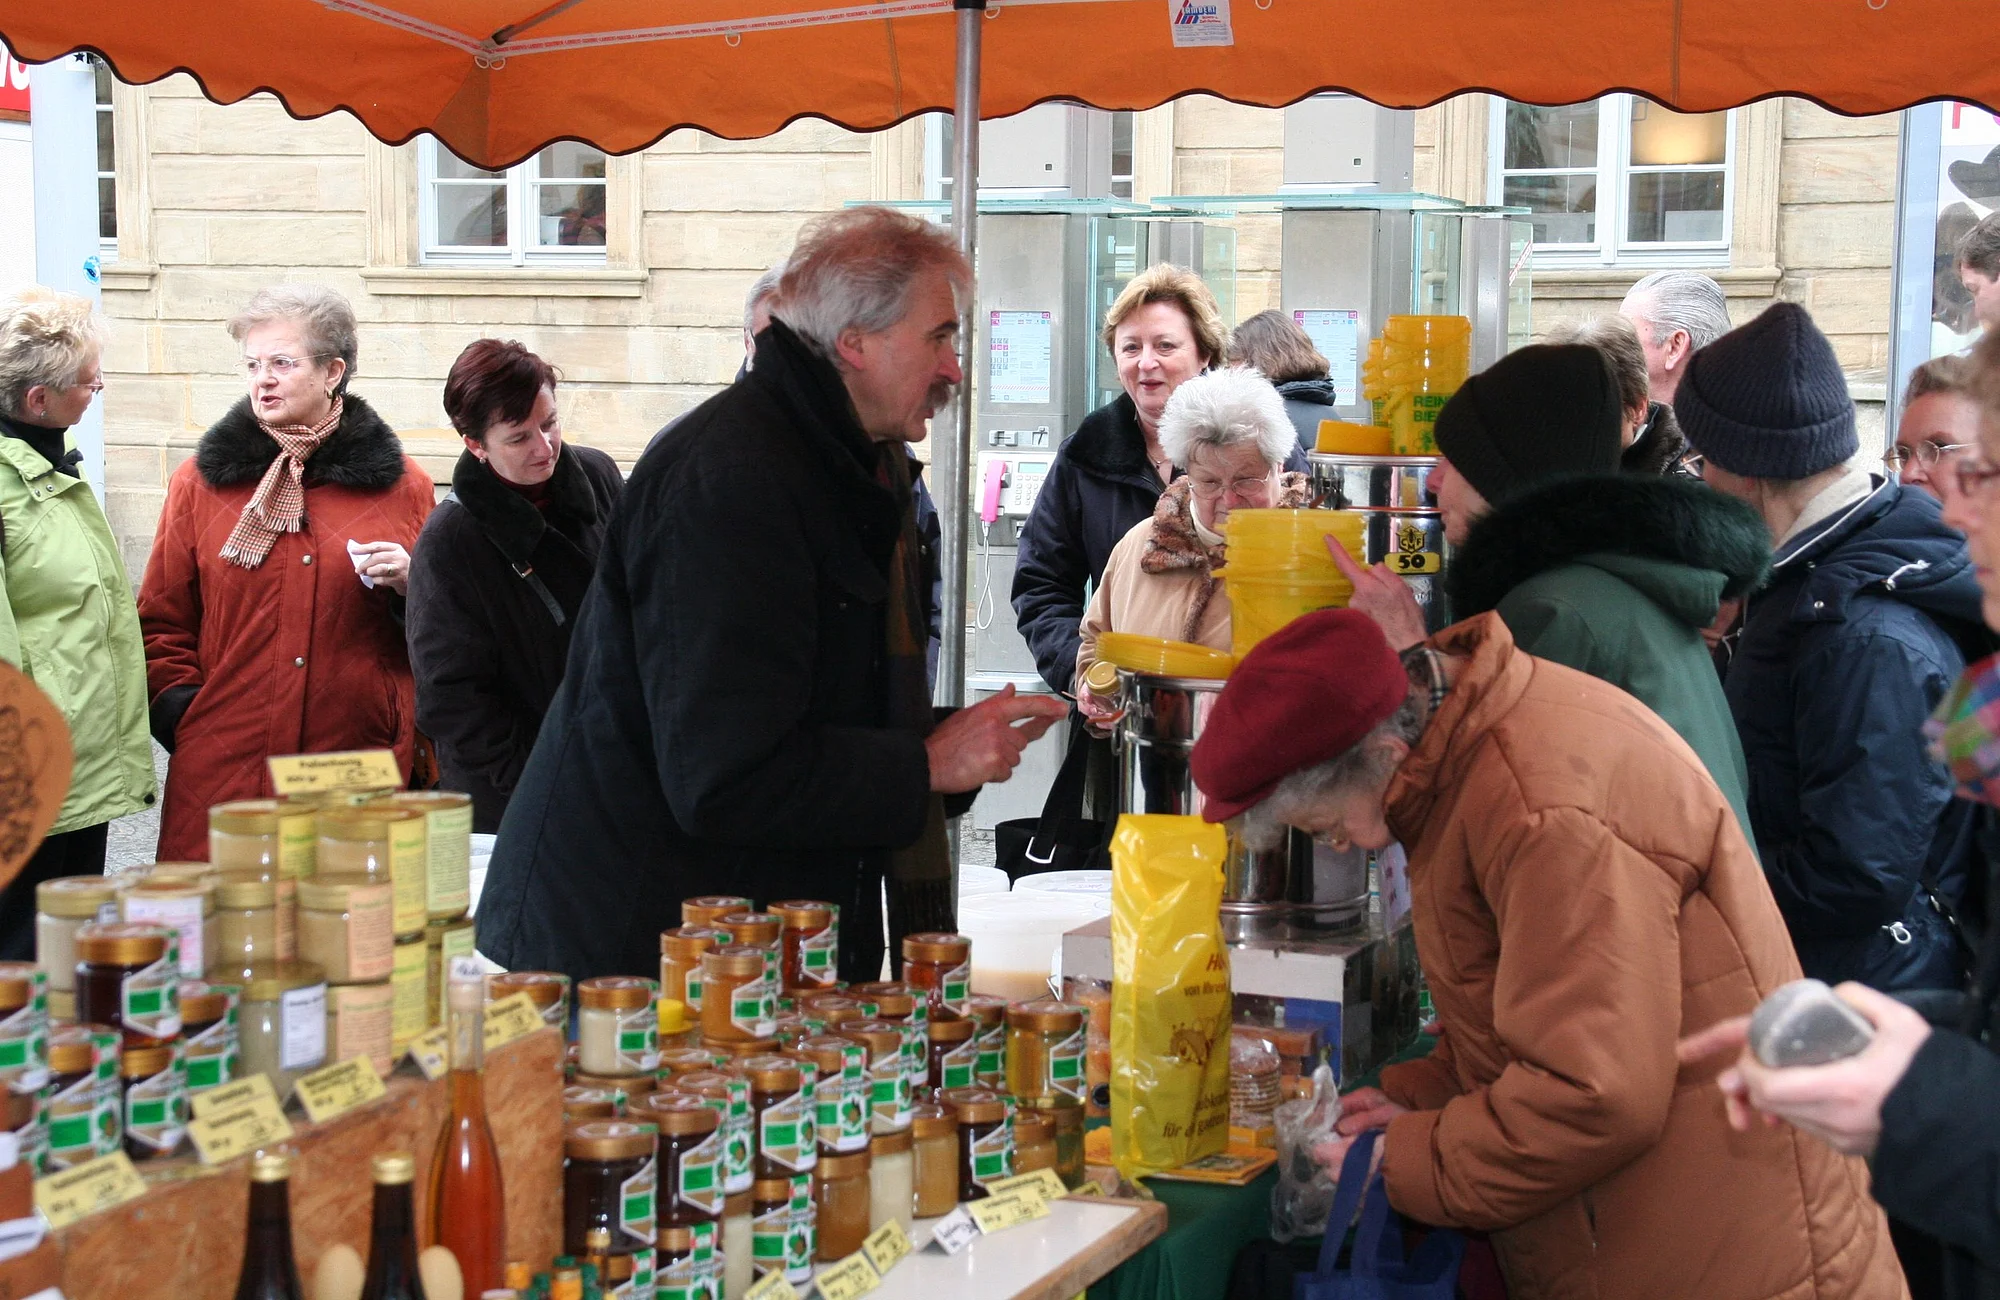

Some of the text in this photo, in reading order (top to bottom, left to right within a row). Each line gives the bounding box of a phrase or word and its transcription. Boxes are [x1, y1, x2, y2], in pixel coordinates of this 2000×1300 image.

[1413, 395, 1449, 408] REIN
[1413, 410, 1437, 422] BIE
[1398, 554, 1426, 569] 50
